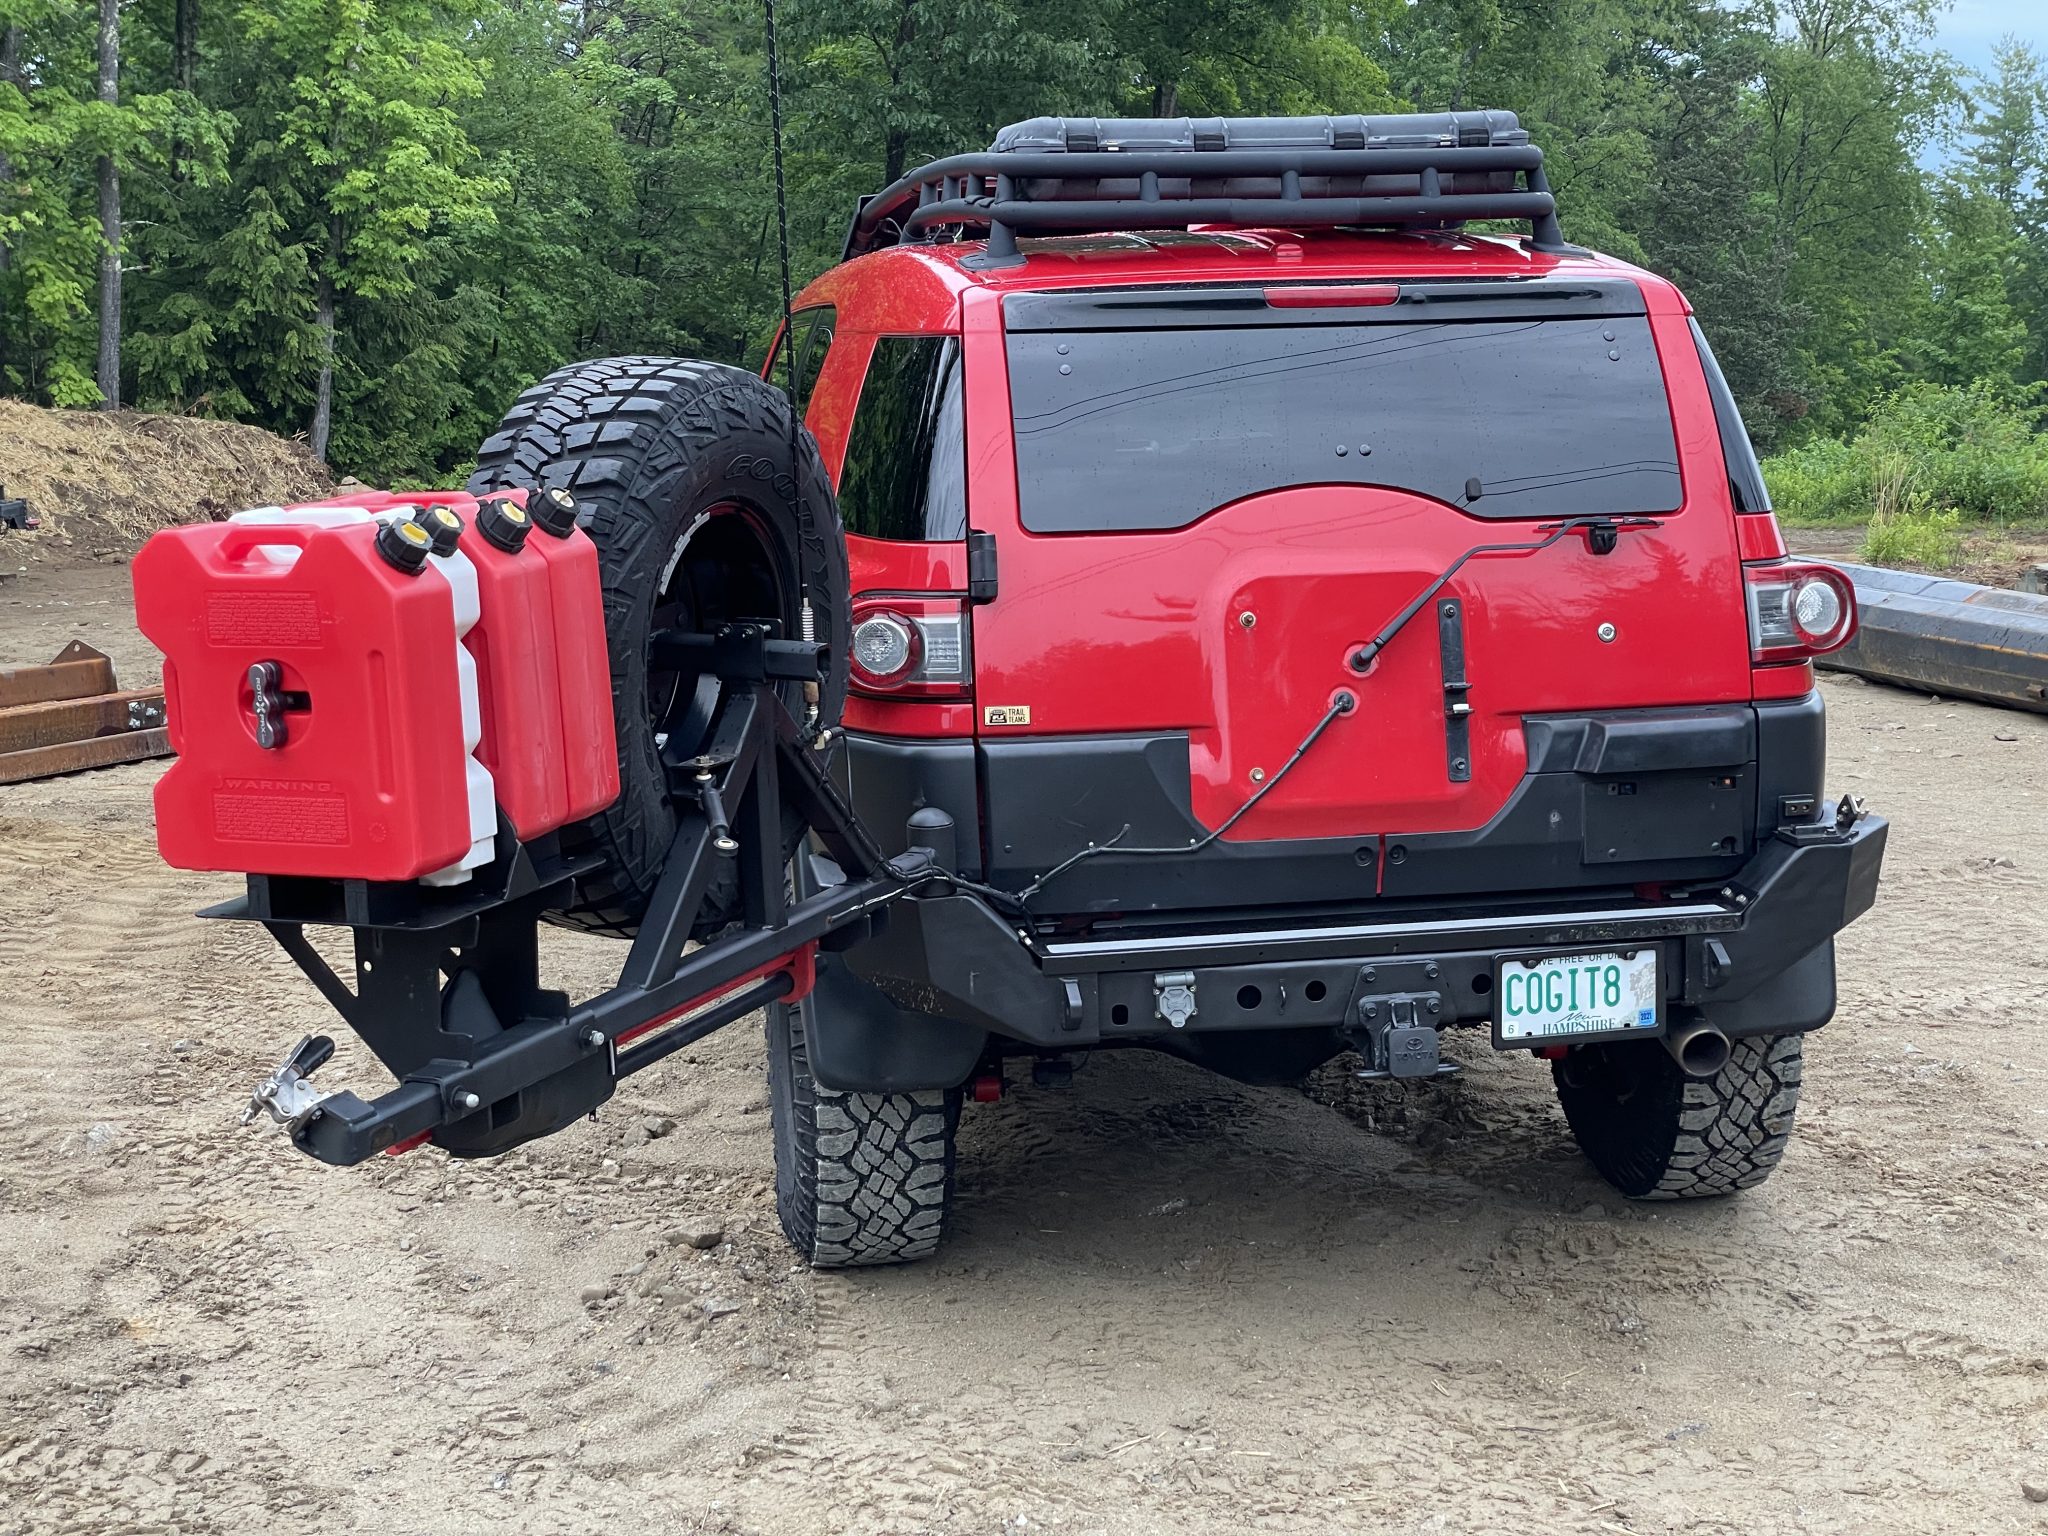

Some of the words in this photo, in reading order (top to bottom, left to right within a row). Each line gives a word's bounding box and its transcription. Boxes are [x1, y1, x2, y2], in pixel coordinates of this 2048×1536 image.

[1008, 708, 1026, 716] TRAIL
[225, 779, 331, 791] WARNING
[1559, 955, 1583, 964] FREE
[1588, 953, 1602, 962] OR
[1506, 965, 1620, 1016] COGIT8
[1556, 1011, 1602, 1023] New
[1640, 1011, 1653, 1021] 2021
[1507, 1024, 1515, 1034] 6
[1542, 1018, 1616, 1034] HAMPSHIRE
[1394, 1050, 1435, 1061] TOYOTA
